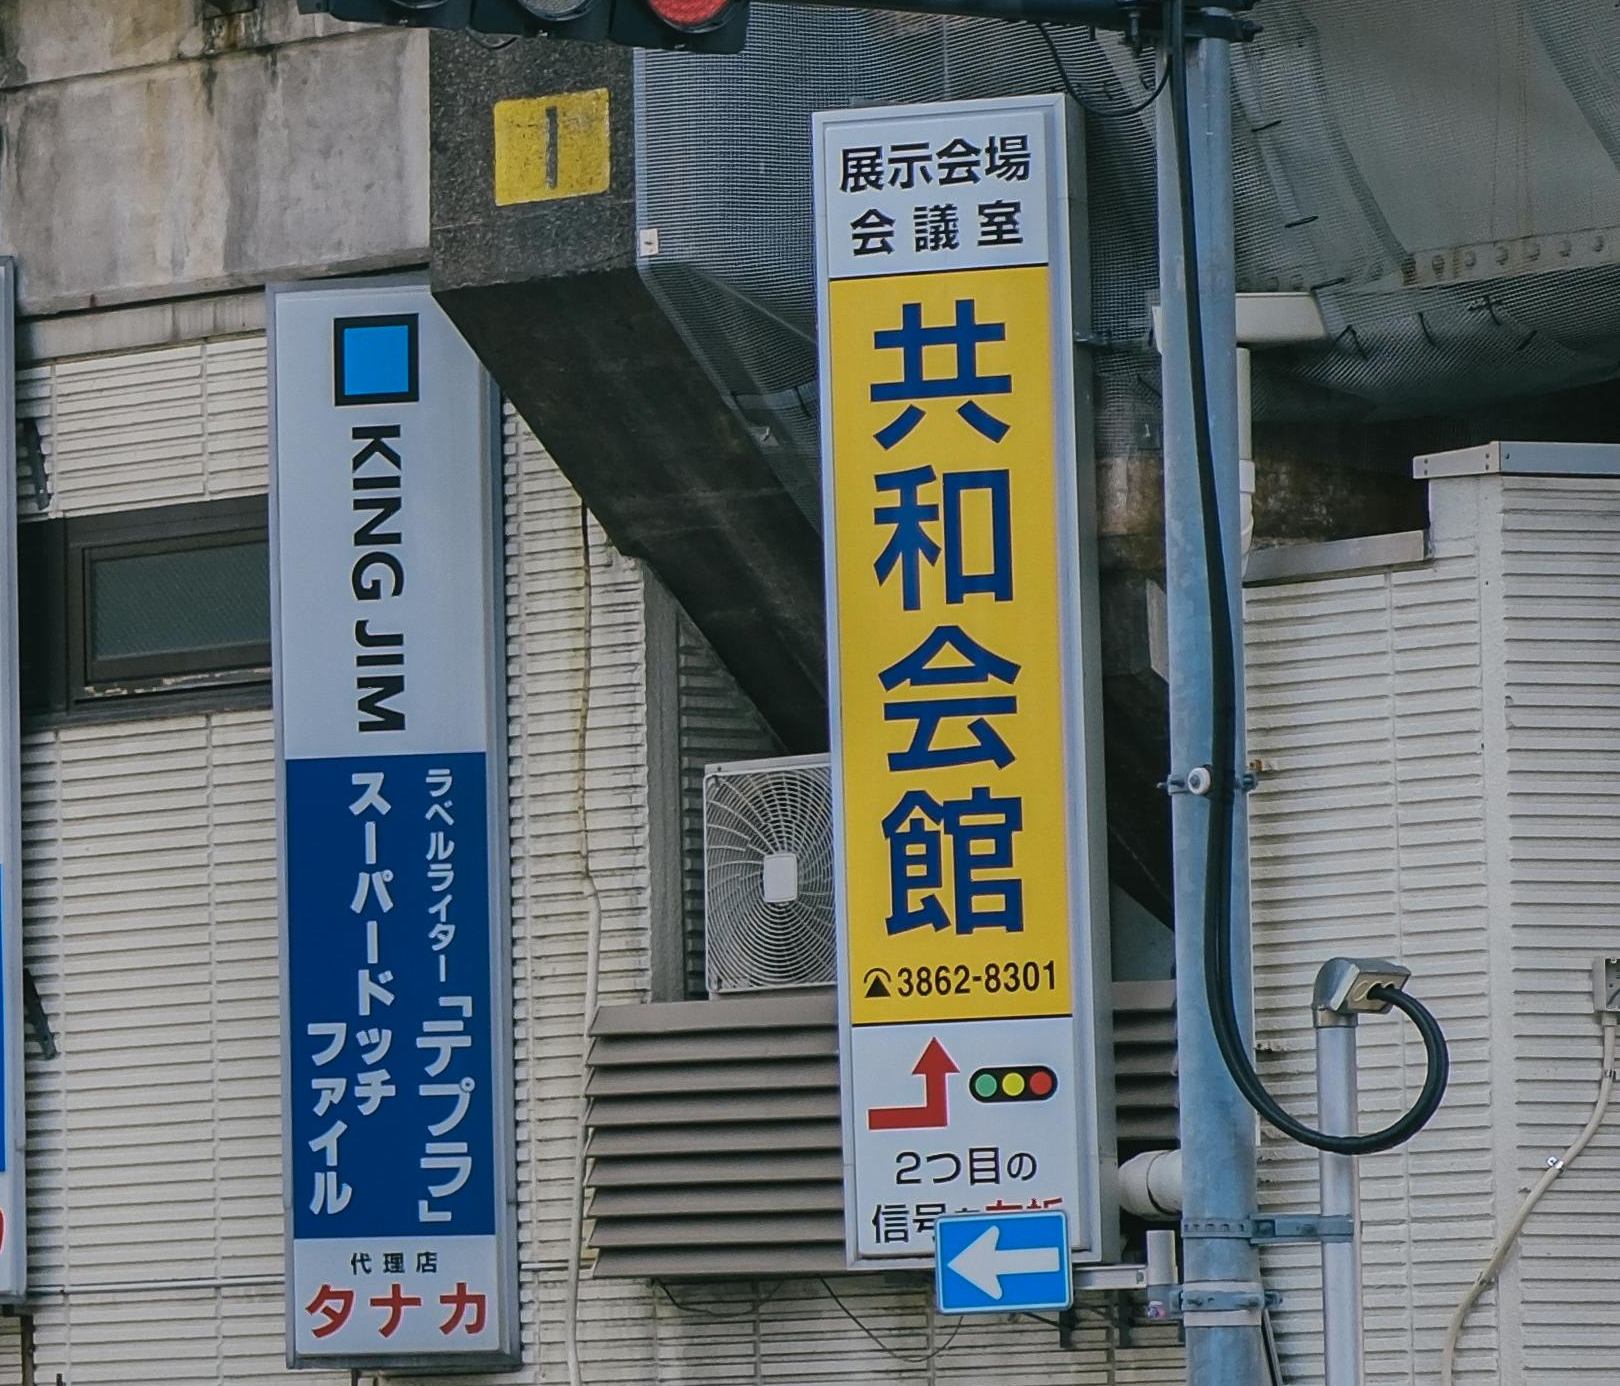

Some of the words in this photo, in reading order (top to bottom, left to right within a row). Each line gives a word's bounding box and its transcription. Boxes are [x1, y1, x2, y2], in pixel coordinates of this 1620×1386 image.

[838, 135, 1031, 191] 展示会場
[850, 199, 1025, 256] 会議室
[350, 425, 404, 598] KING
[869, 299, 1026, 937] 共和会館
[350, 608, 406, 733] JIM
[350, 771, 395, 1116] スーパードッチ
[896, 961, 1058, 997] 3862-8301
[307, 1021, 352, 1215] ファイル
[895, 1146, 1038, 1186] 2つ目の
[350, 1251, 439, 1275] 代理店
[305, 1281, 488, 1340] タナカ
